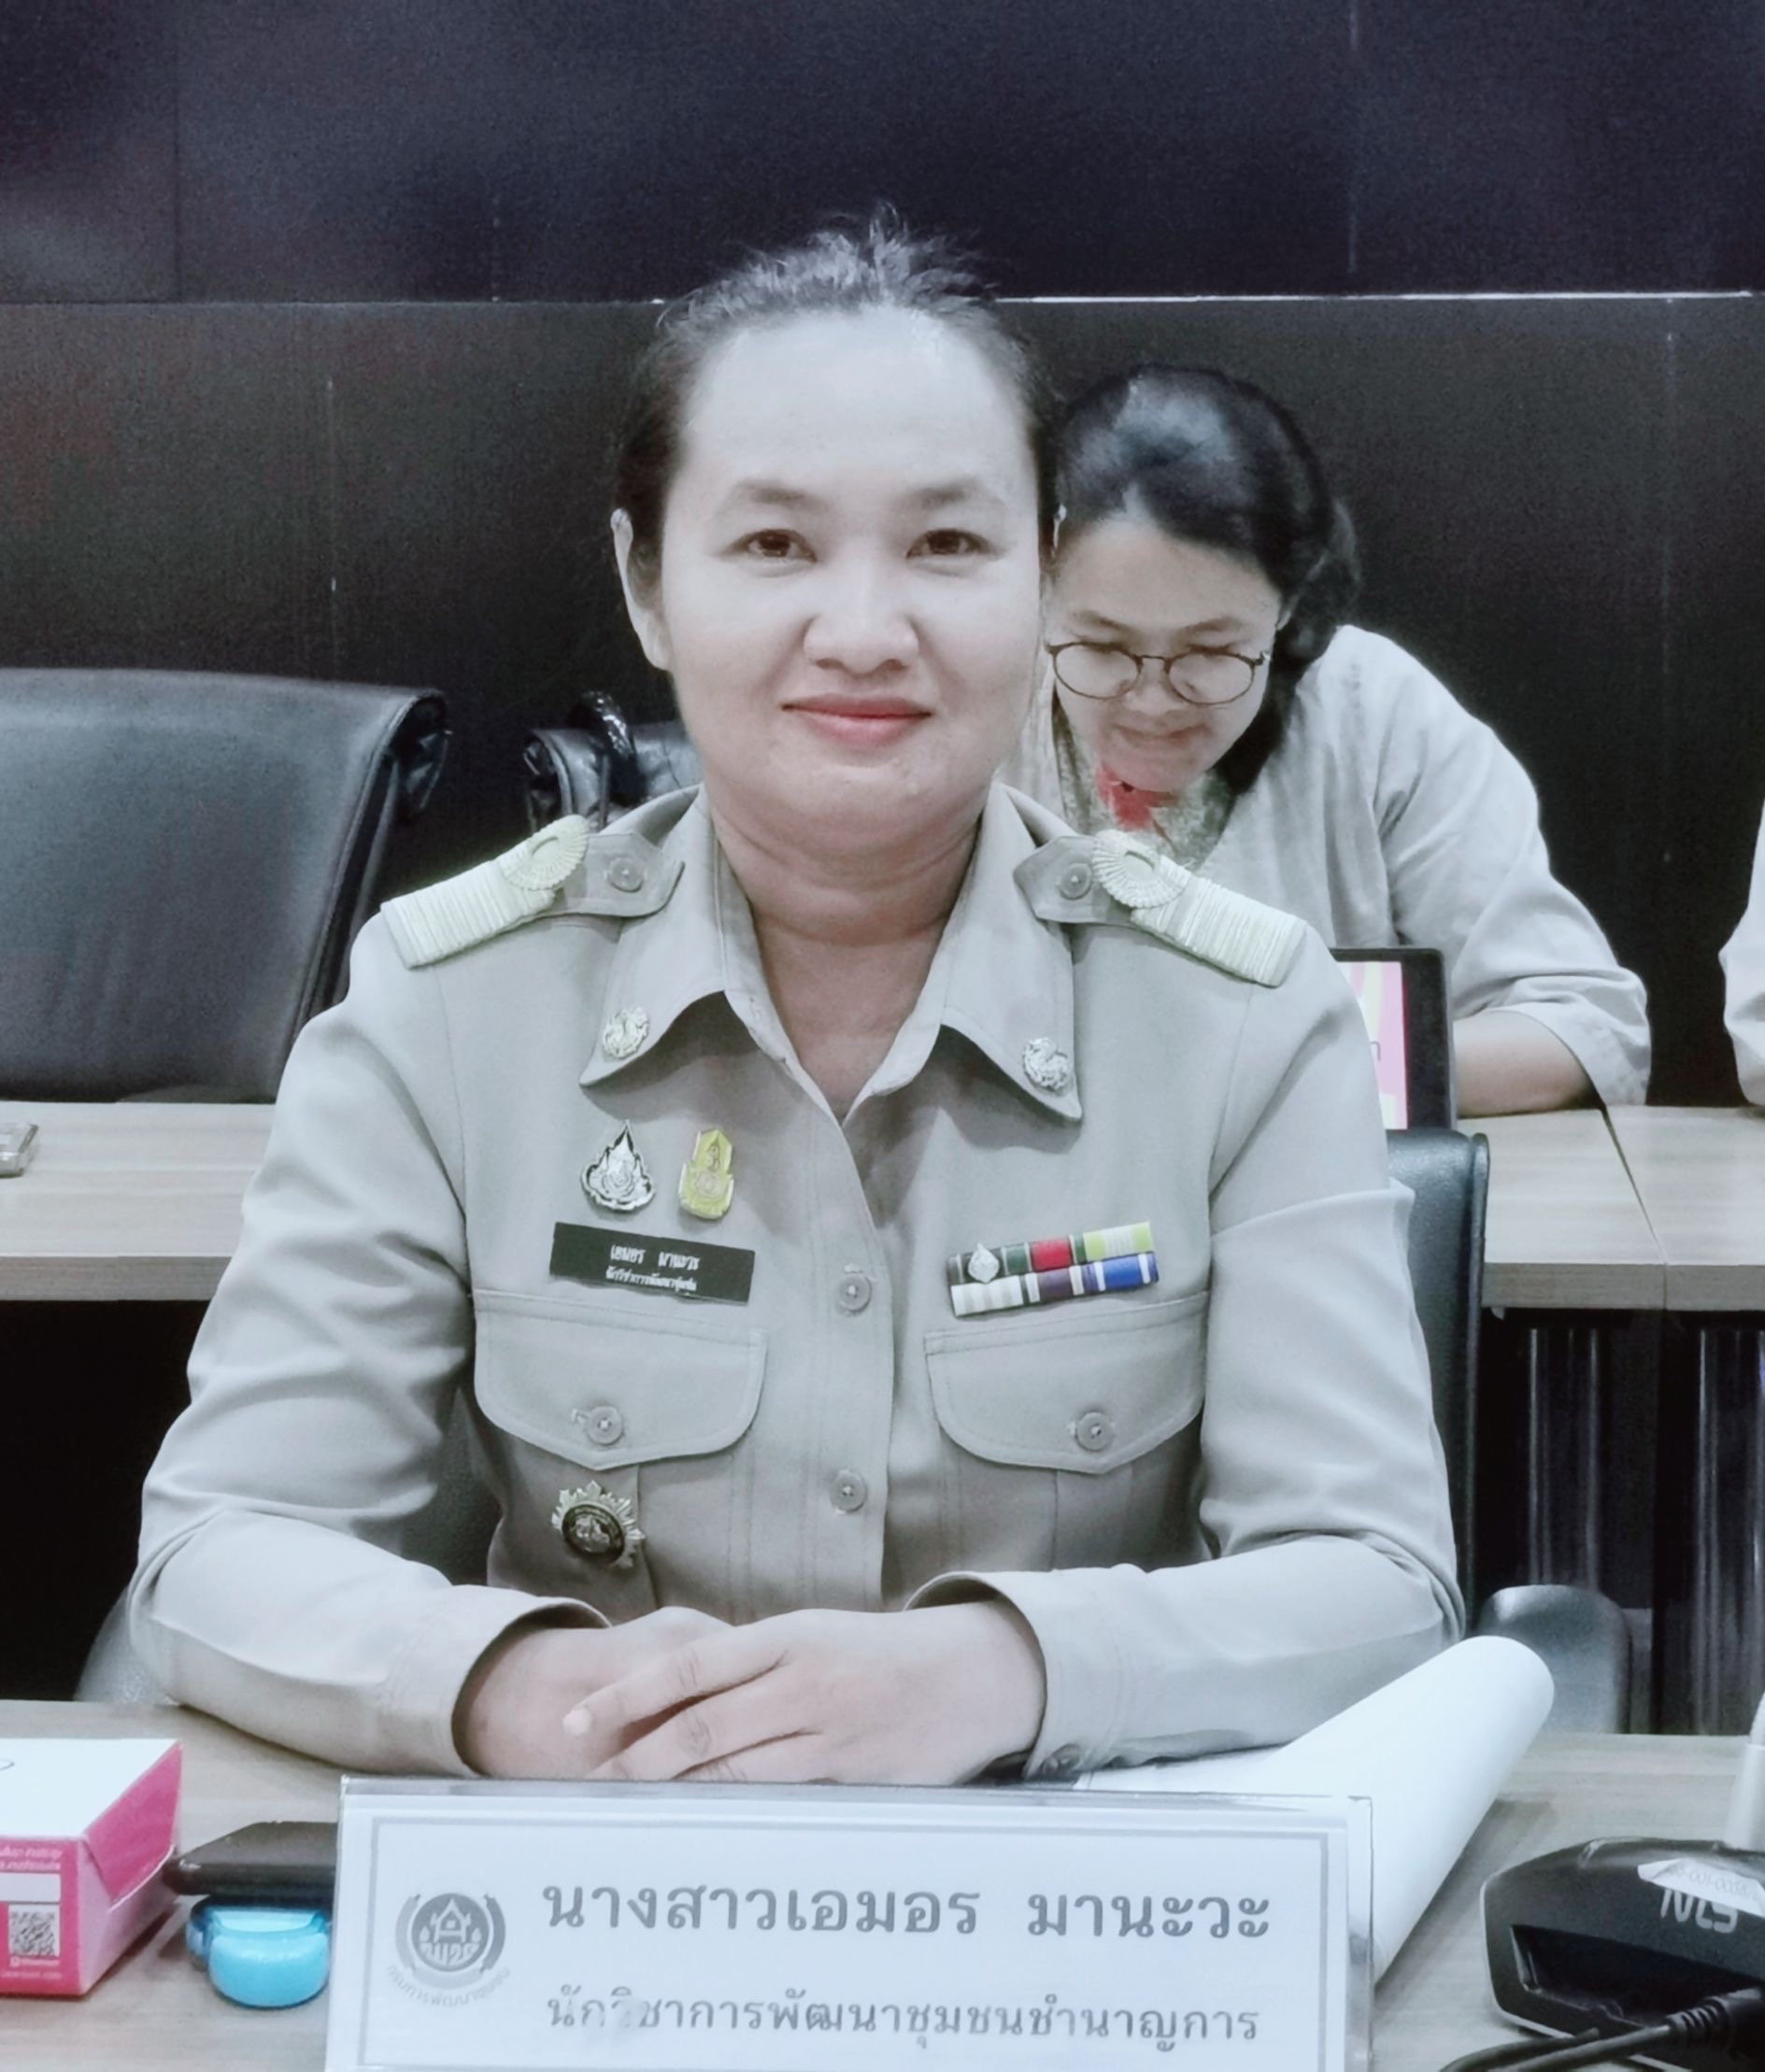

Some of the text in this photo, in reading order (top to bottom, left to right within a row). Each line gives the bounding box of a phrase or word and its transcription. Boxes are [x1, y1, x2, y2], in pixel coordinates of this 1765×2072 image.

[542, 1884, 1270, 1939] นางสาวเอมอร มานะวะ
